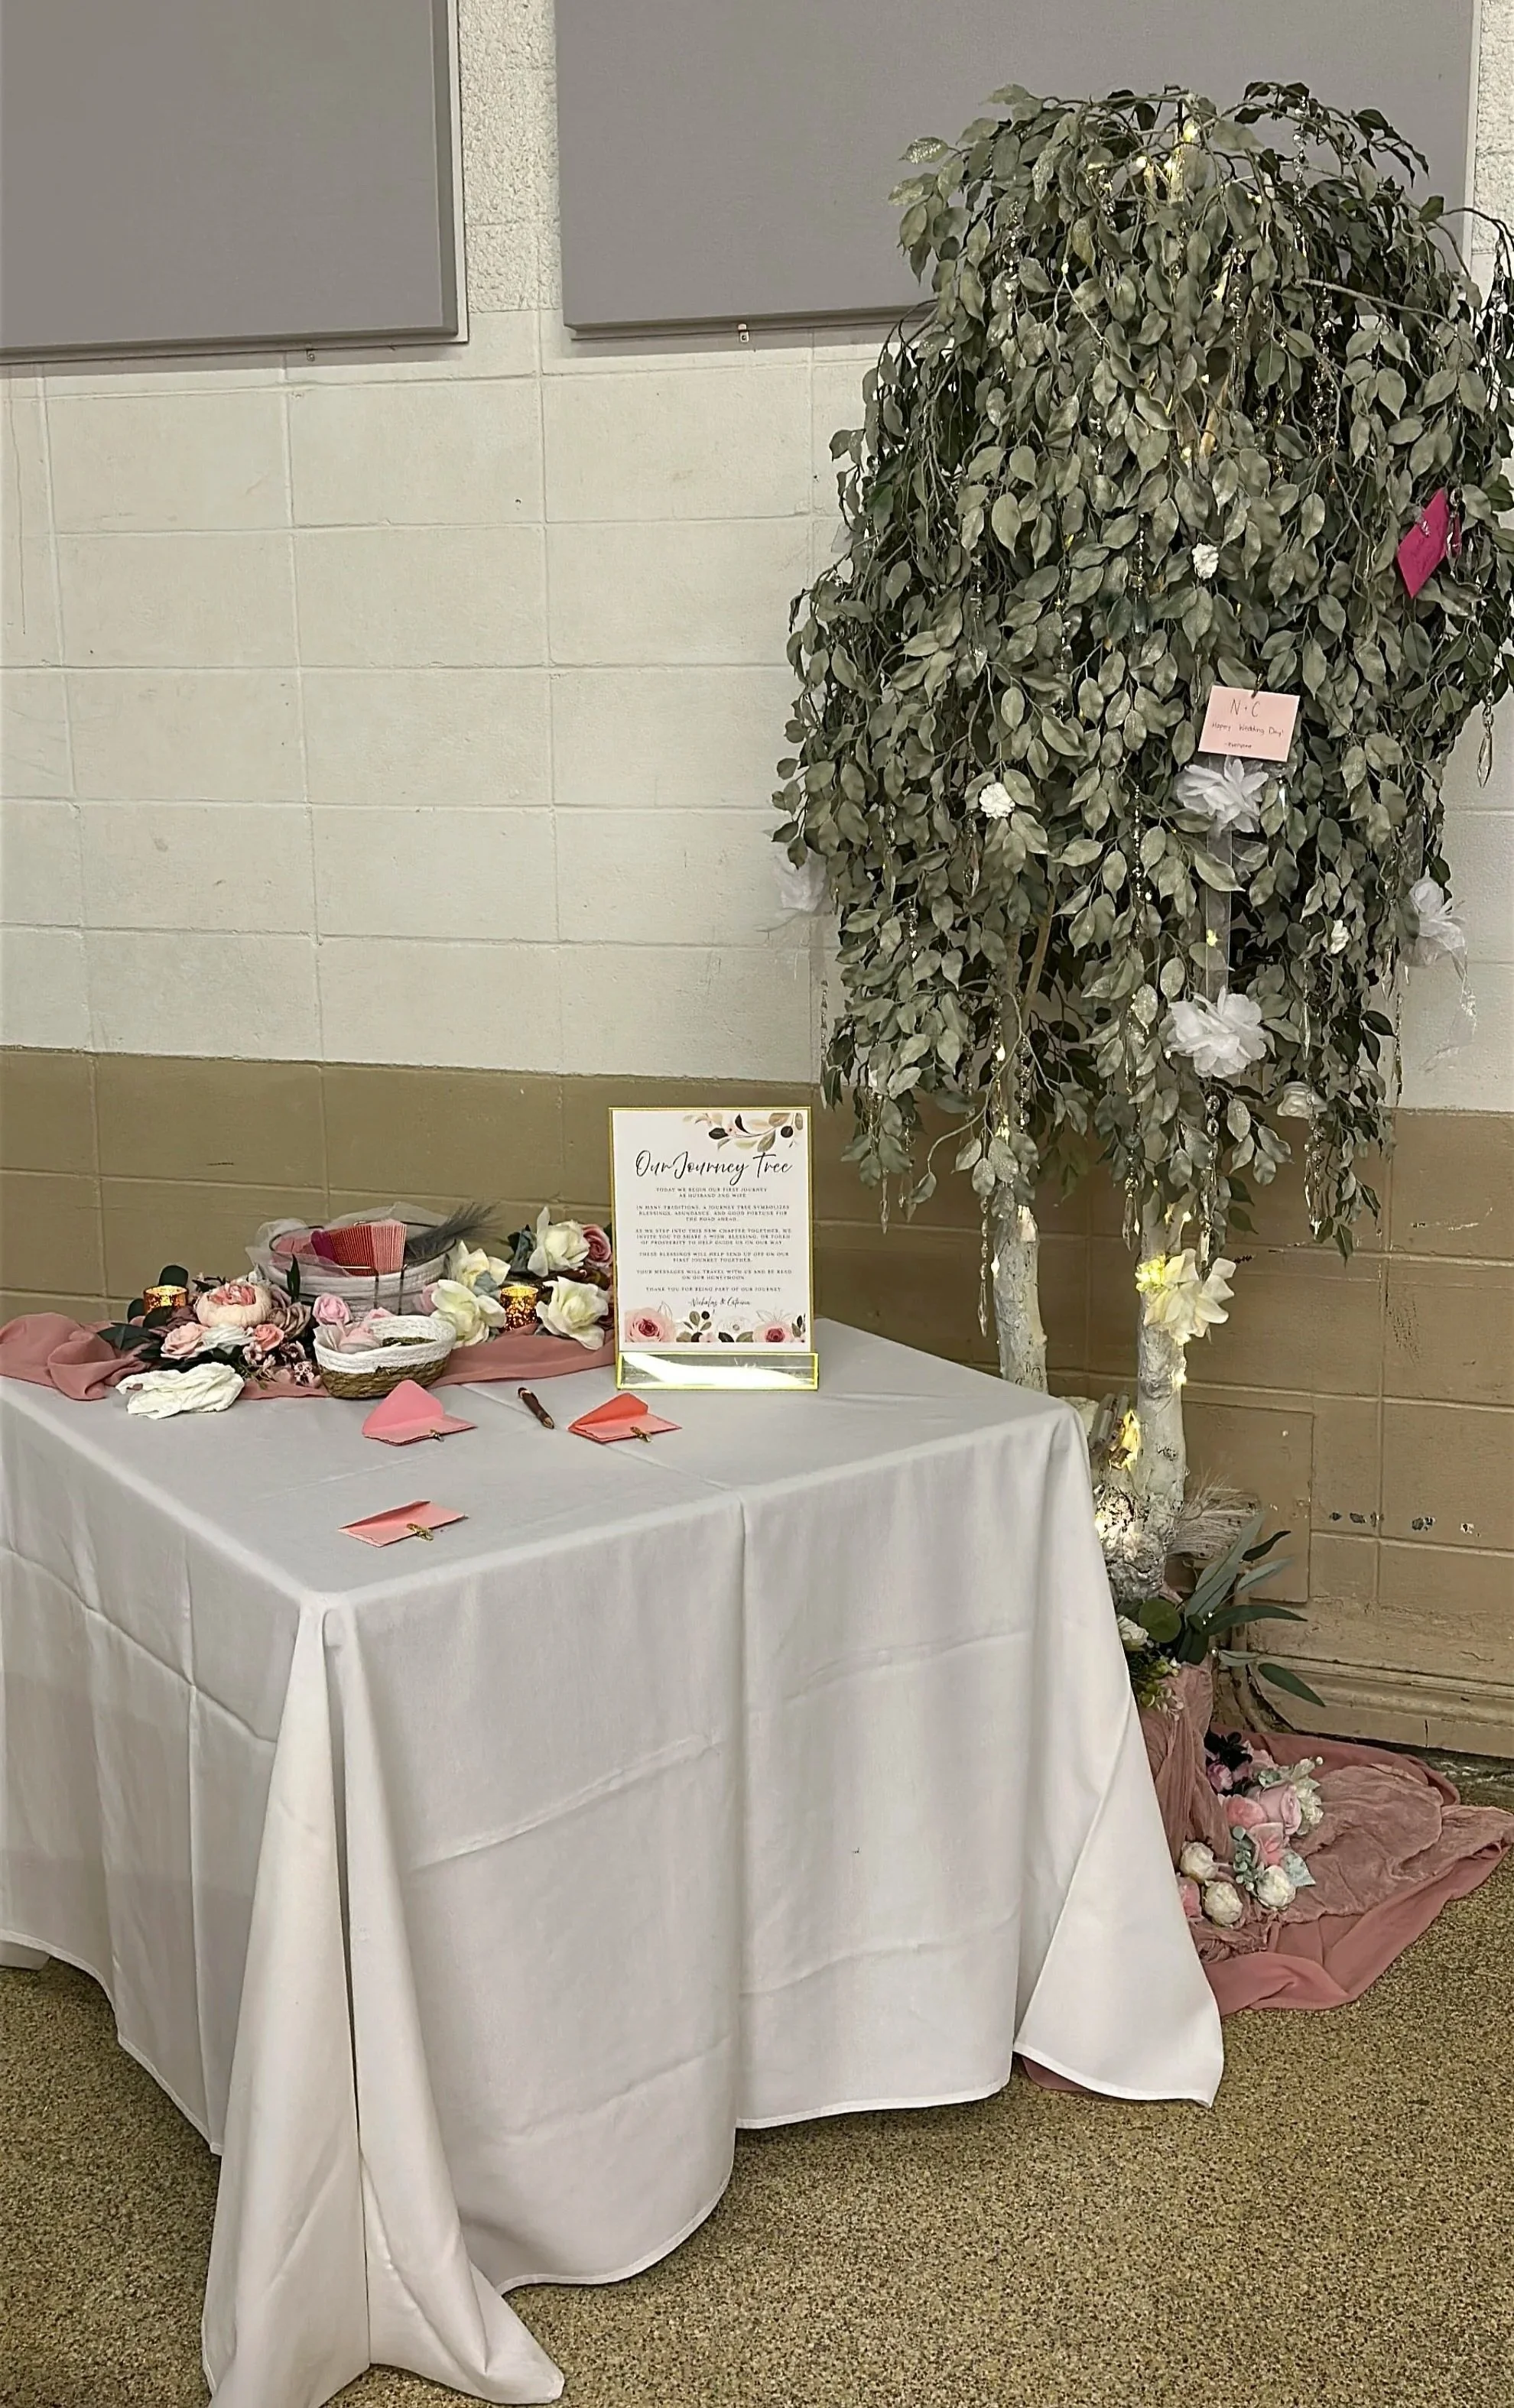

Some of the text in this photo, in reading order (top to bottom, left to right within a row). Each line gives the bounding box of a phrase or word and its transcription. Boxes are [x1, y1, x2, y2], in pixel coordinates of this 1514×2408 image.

[1211, 722, 1231, 732] Happy
[1239, 723, 1265, 736] Wedding
[635, 1150, 793, 1186] Our Journey Tree
